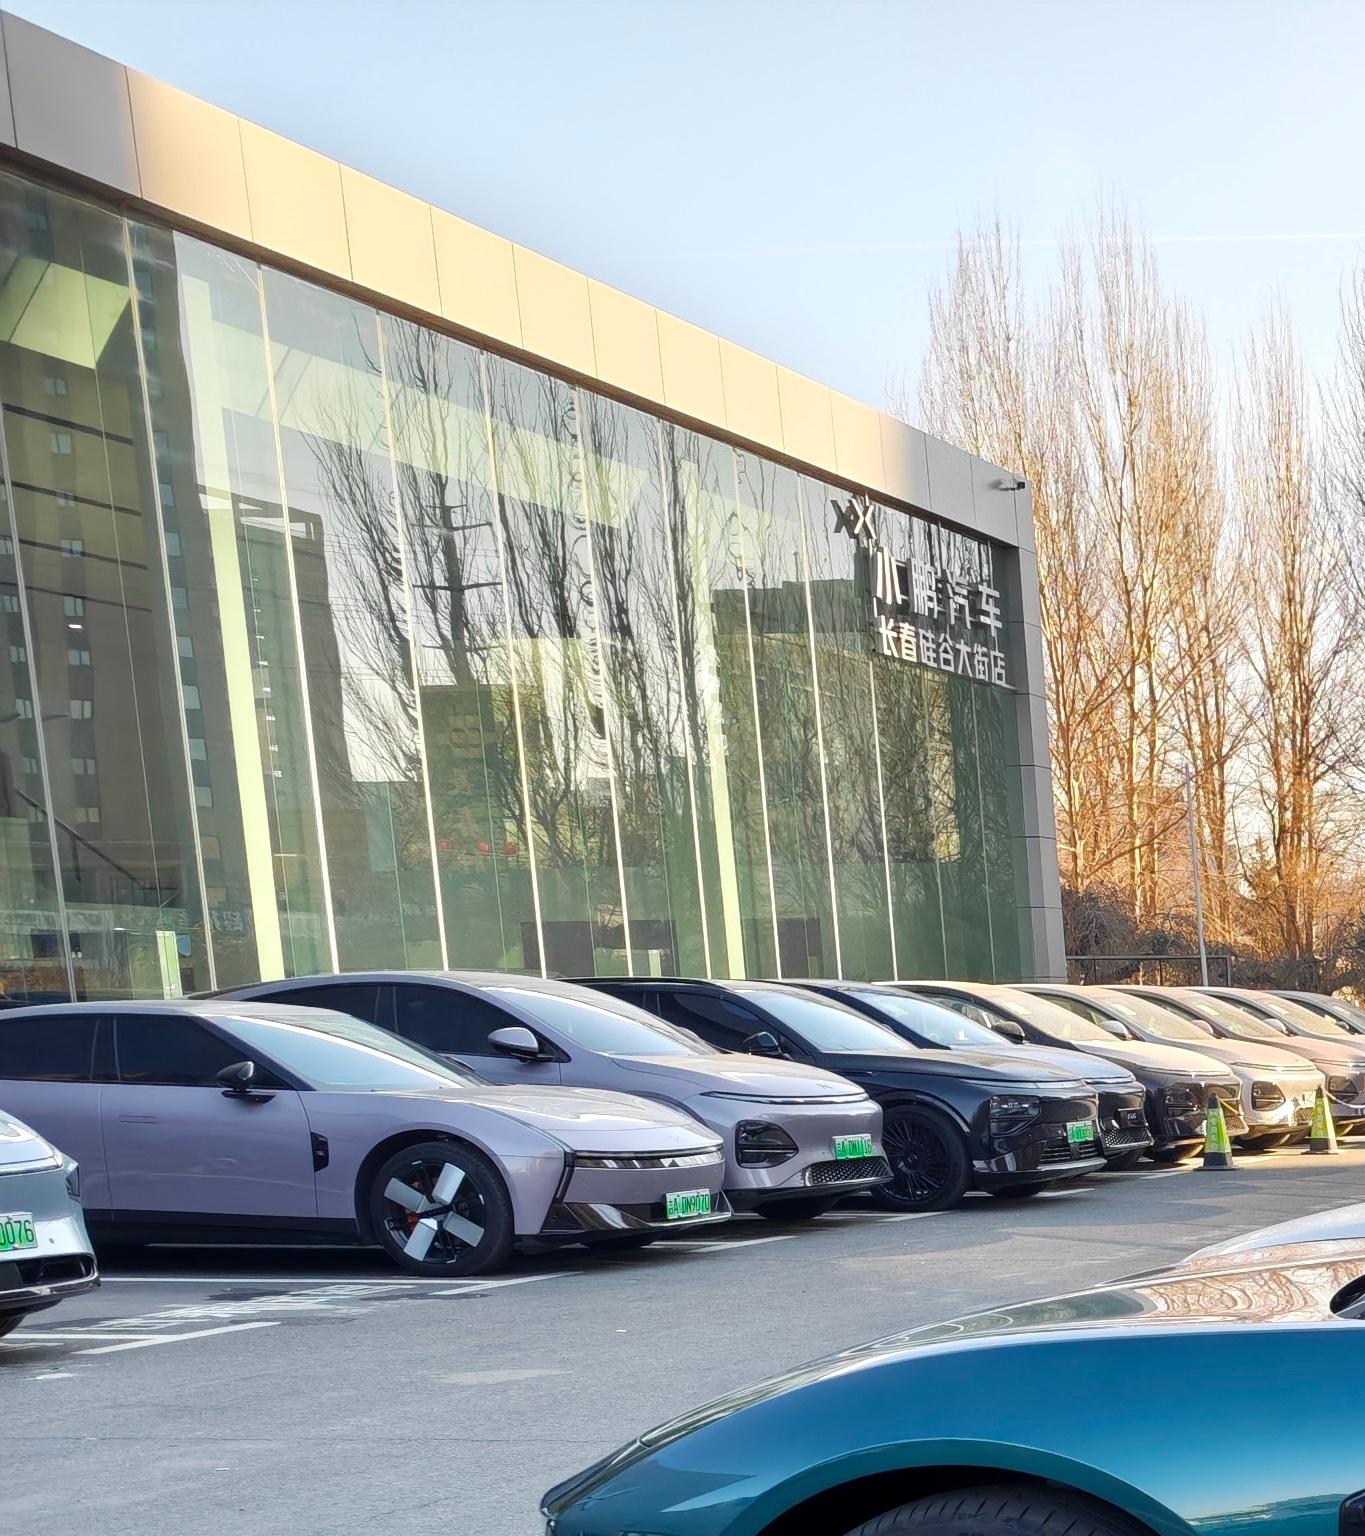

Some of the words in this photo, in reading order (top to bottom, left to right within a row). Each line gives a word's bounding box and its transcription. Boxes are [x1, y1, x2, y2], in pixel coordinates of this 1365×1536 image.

[877, 547, 1003, 637] 小鹏汽车
[880, 615, 1006, 686] 长春硅谷大街店
